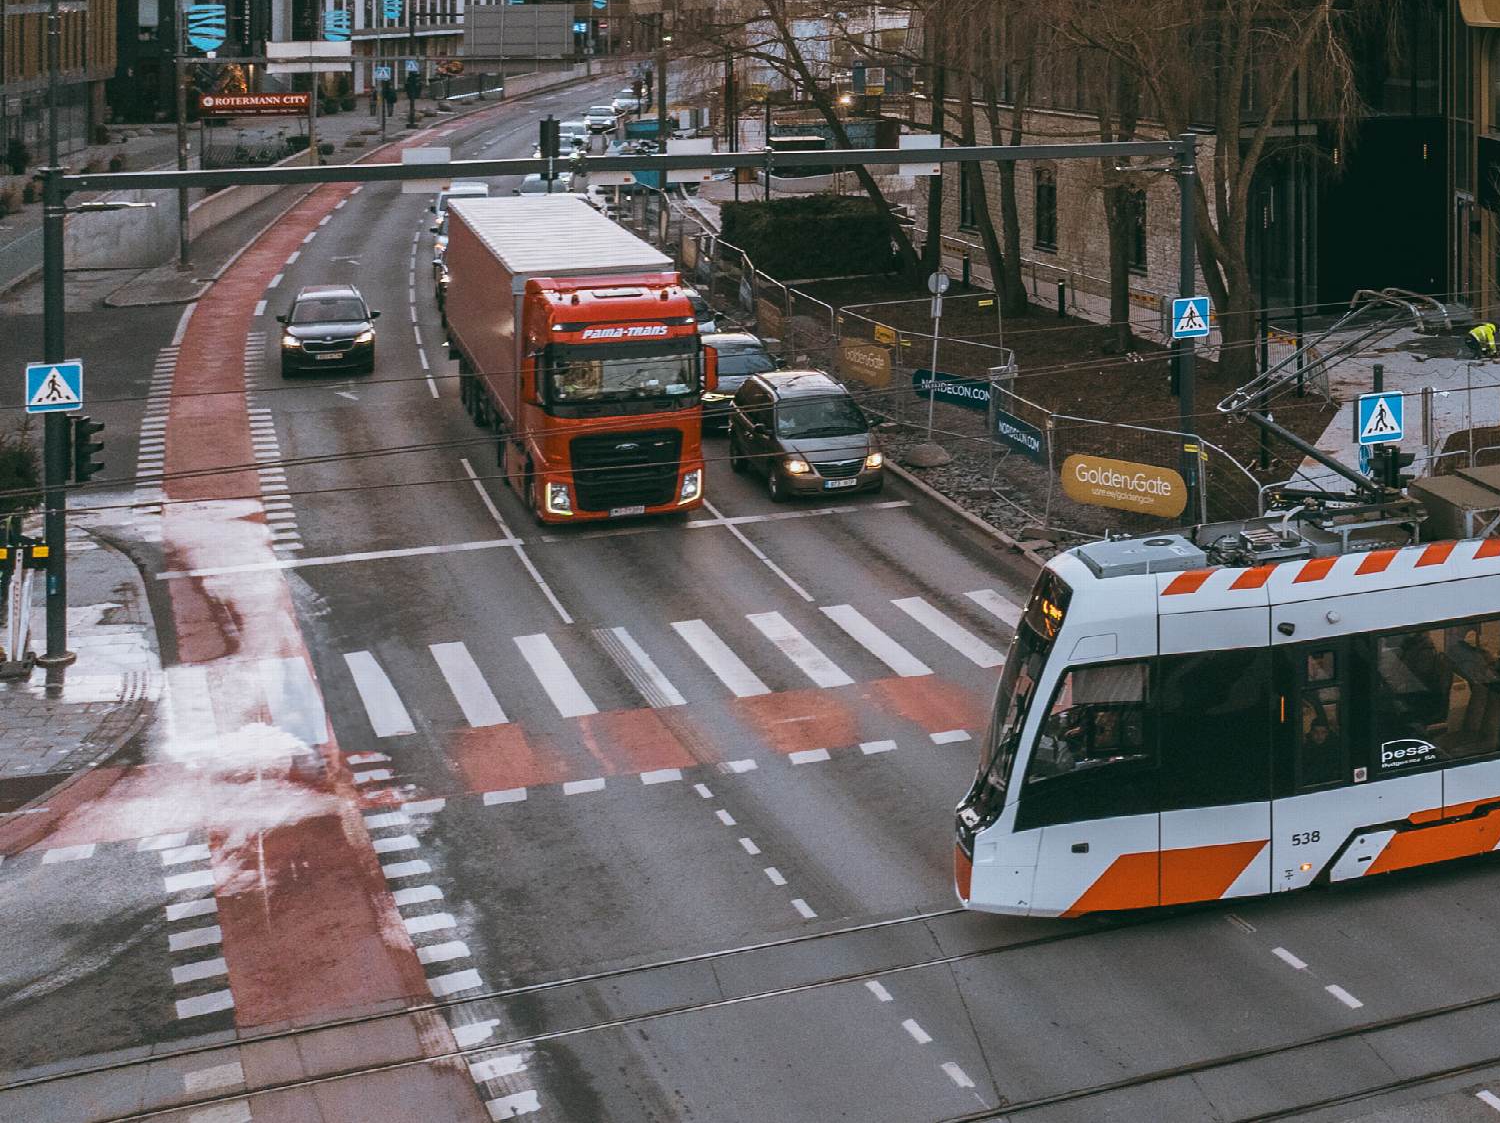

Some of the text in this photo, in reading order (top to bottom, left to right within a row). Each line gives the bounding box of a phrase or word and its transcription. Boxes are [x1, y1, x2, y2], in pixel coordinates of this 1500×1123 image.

[215, 95, 307, 106] ROTERMANN CITY
[1075, 463, 1172, 496] GoldenGate
[1381, 743, 1431, 763] pesa
[1291, 830, 1321, 846] 538
